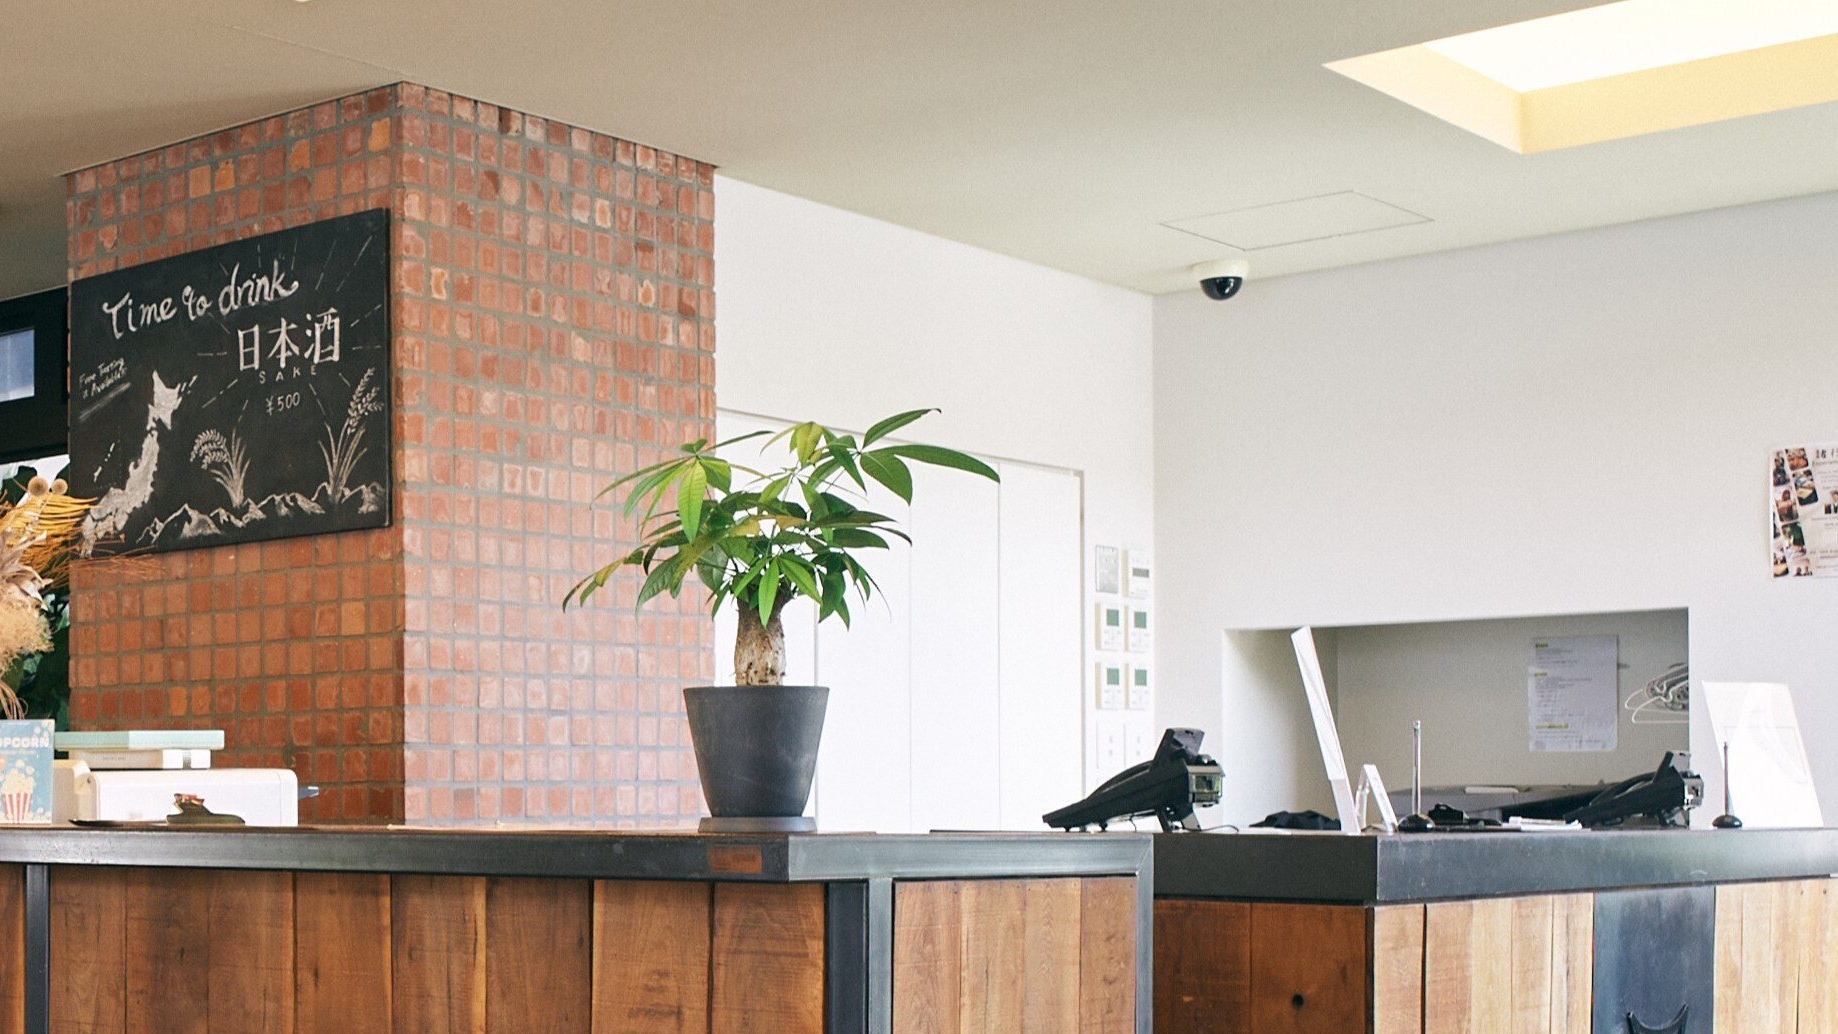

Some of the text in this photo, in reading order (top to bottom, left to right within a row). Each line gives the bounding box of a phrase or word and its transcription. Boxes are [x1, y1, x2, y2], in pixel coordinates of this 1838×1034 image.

[102, 260, 299, 339] Time to drink
[237, 307, 340, 371] 日本酒
[266, 392, 300, 416] ¥500
